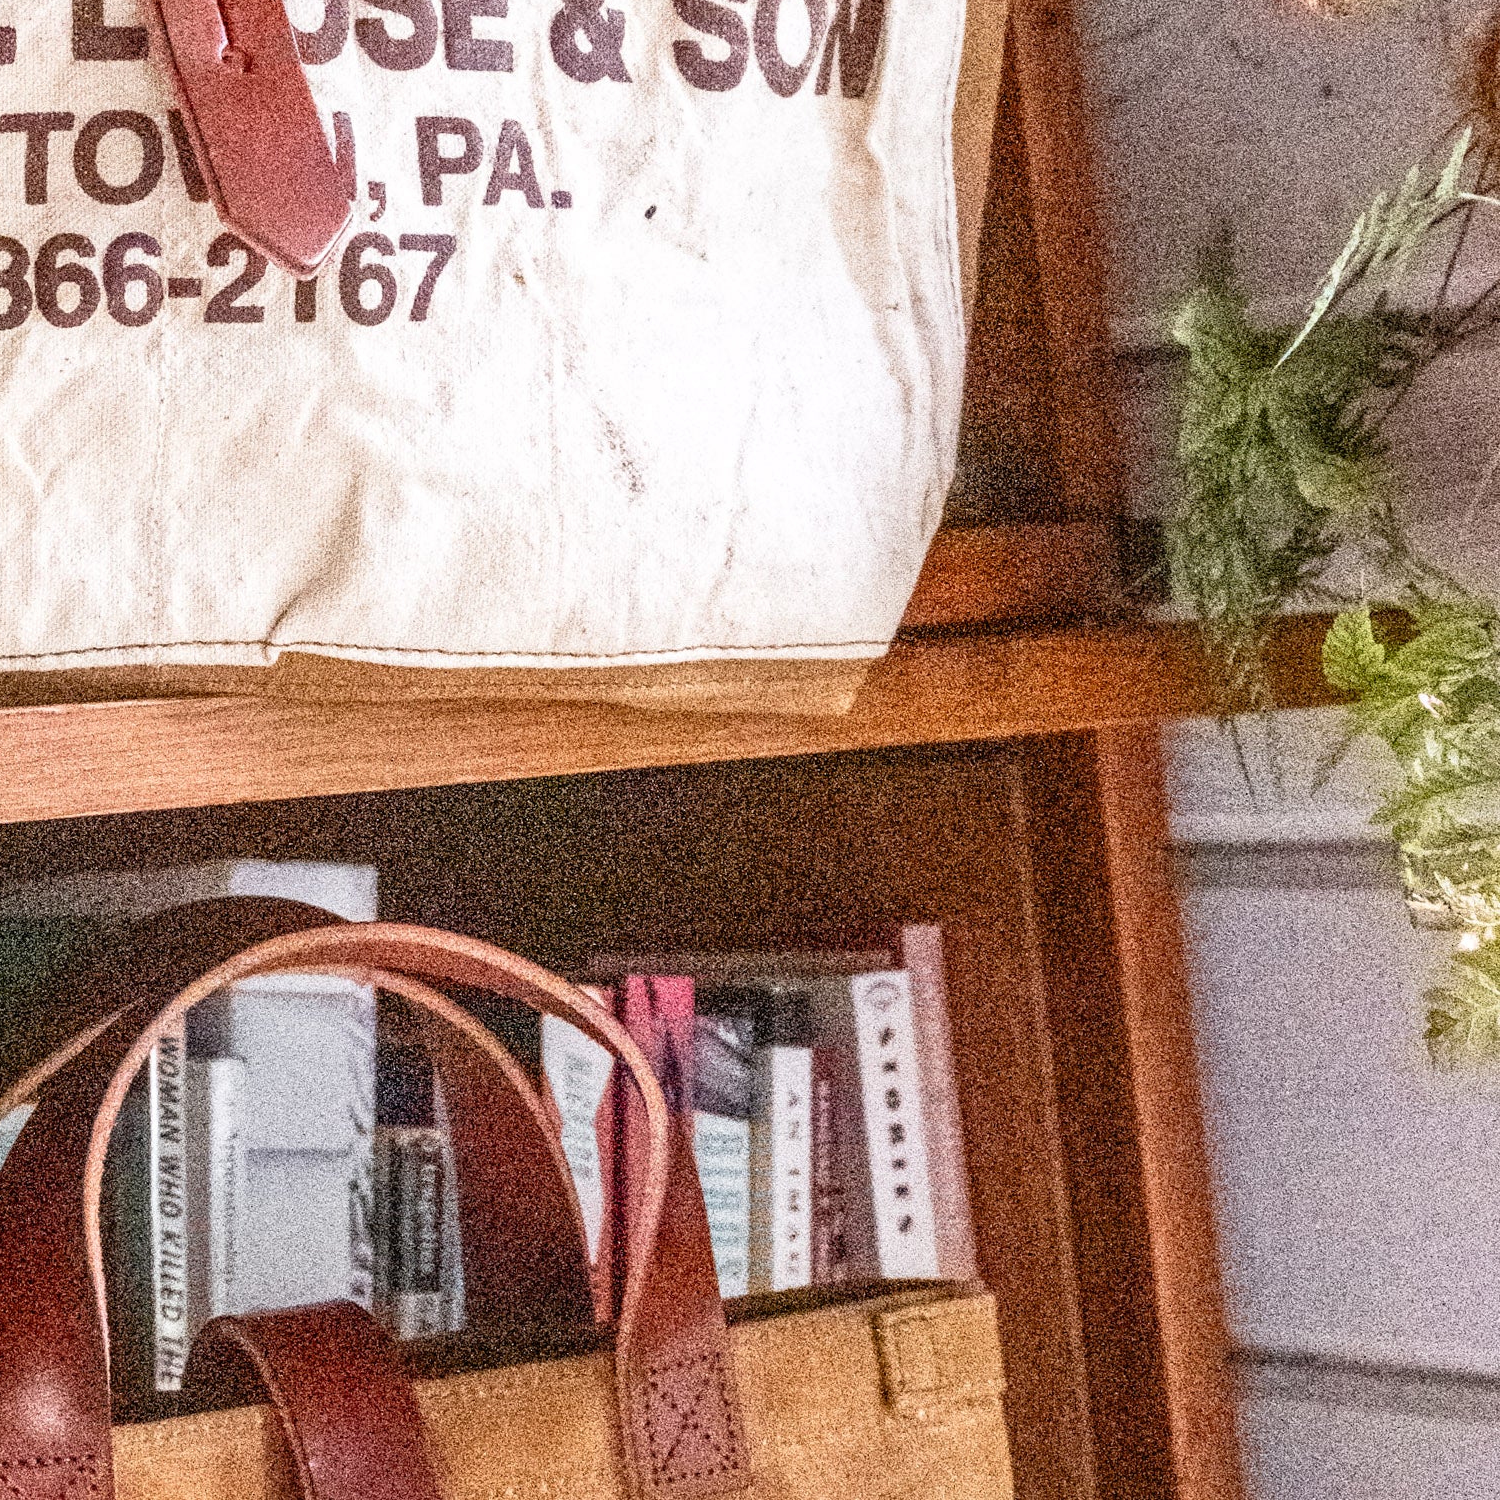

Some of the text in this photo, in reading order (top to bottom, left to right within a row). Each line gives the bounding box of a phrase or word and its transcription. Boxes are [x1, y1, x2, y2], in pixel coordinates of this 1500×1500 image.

[415, 115, 573, 210] PA.
[158, 1036, 184, 1384] WOMAN WHO KILLED THE
[879, 1025, 917, 1234] STORIES
